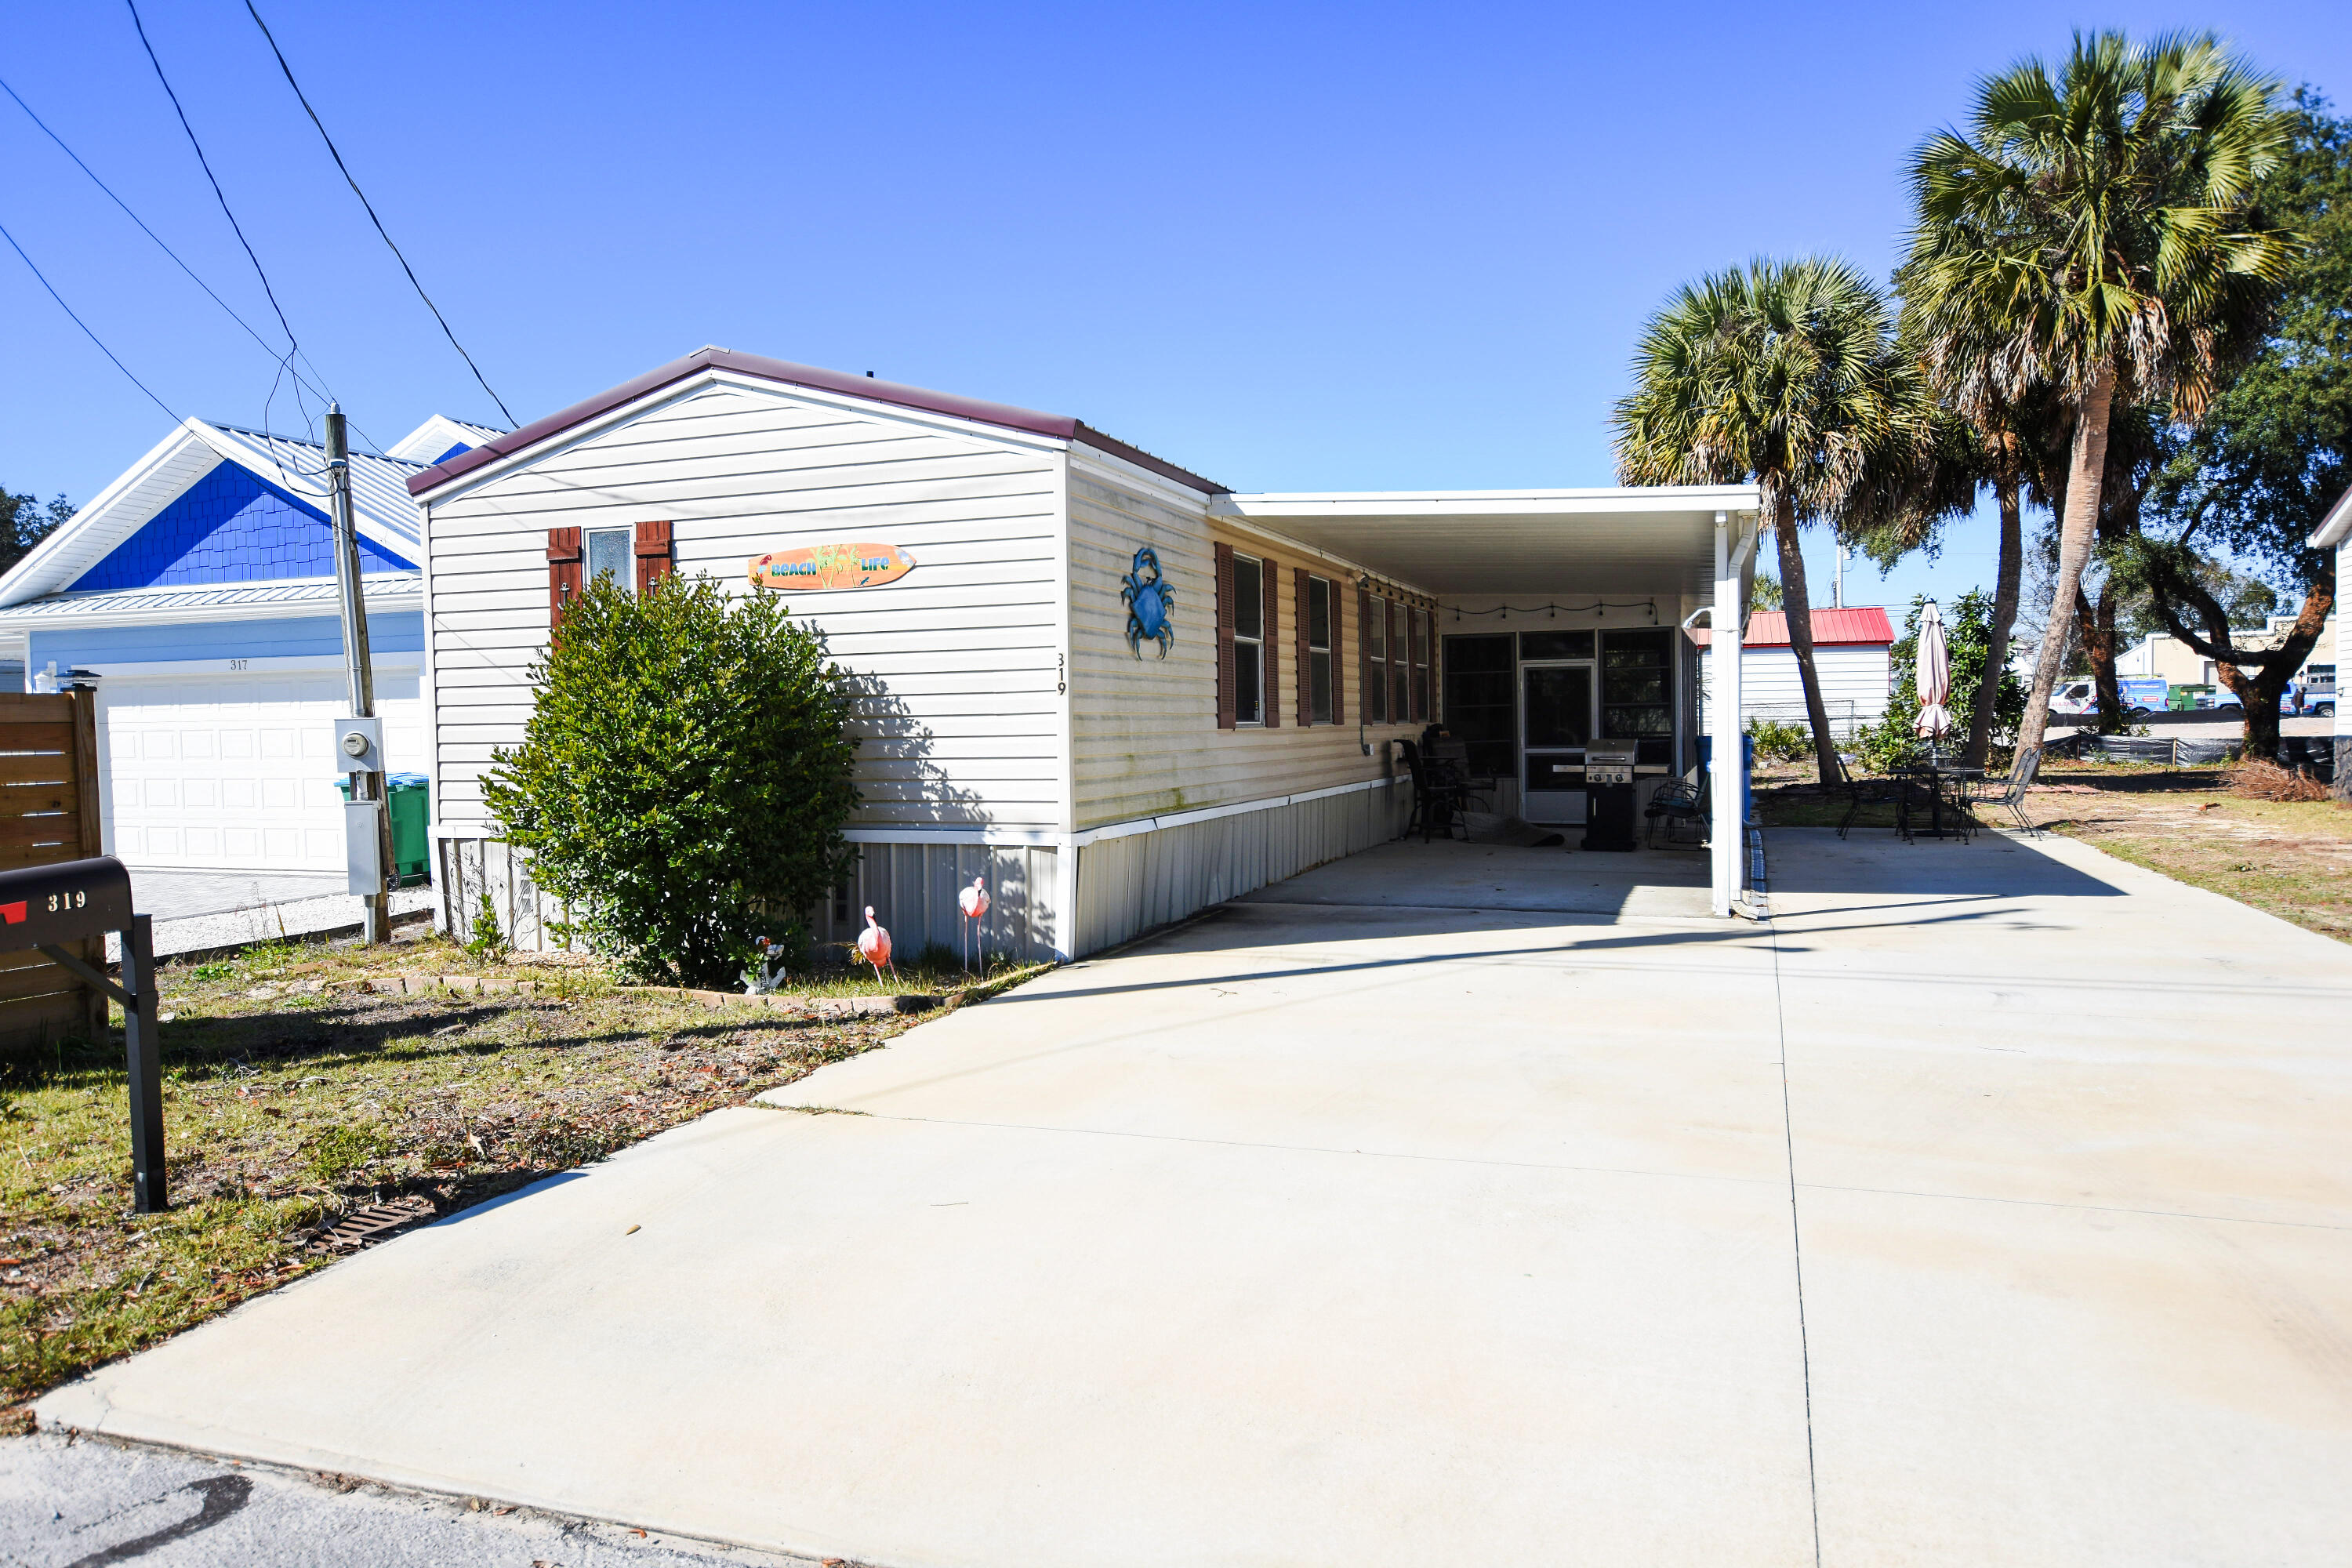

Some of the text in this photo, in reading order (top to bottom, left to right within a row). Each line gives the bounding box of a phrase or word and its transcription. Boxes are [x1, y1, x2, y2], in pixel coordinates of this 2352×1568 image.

[230, 659, 248, 670] 317
[1058, 652, 1066, 696] 319
[48, 891, 85, 912] 319
